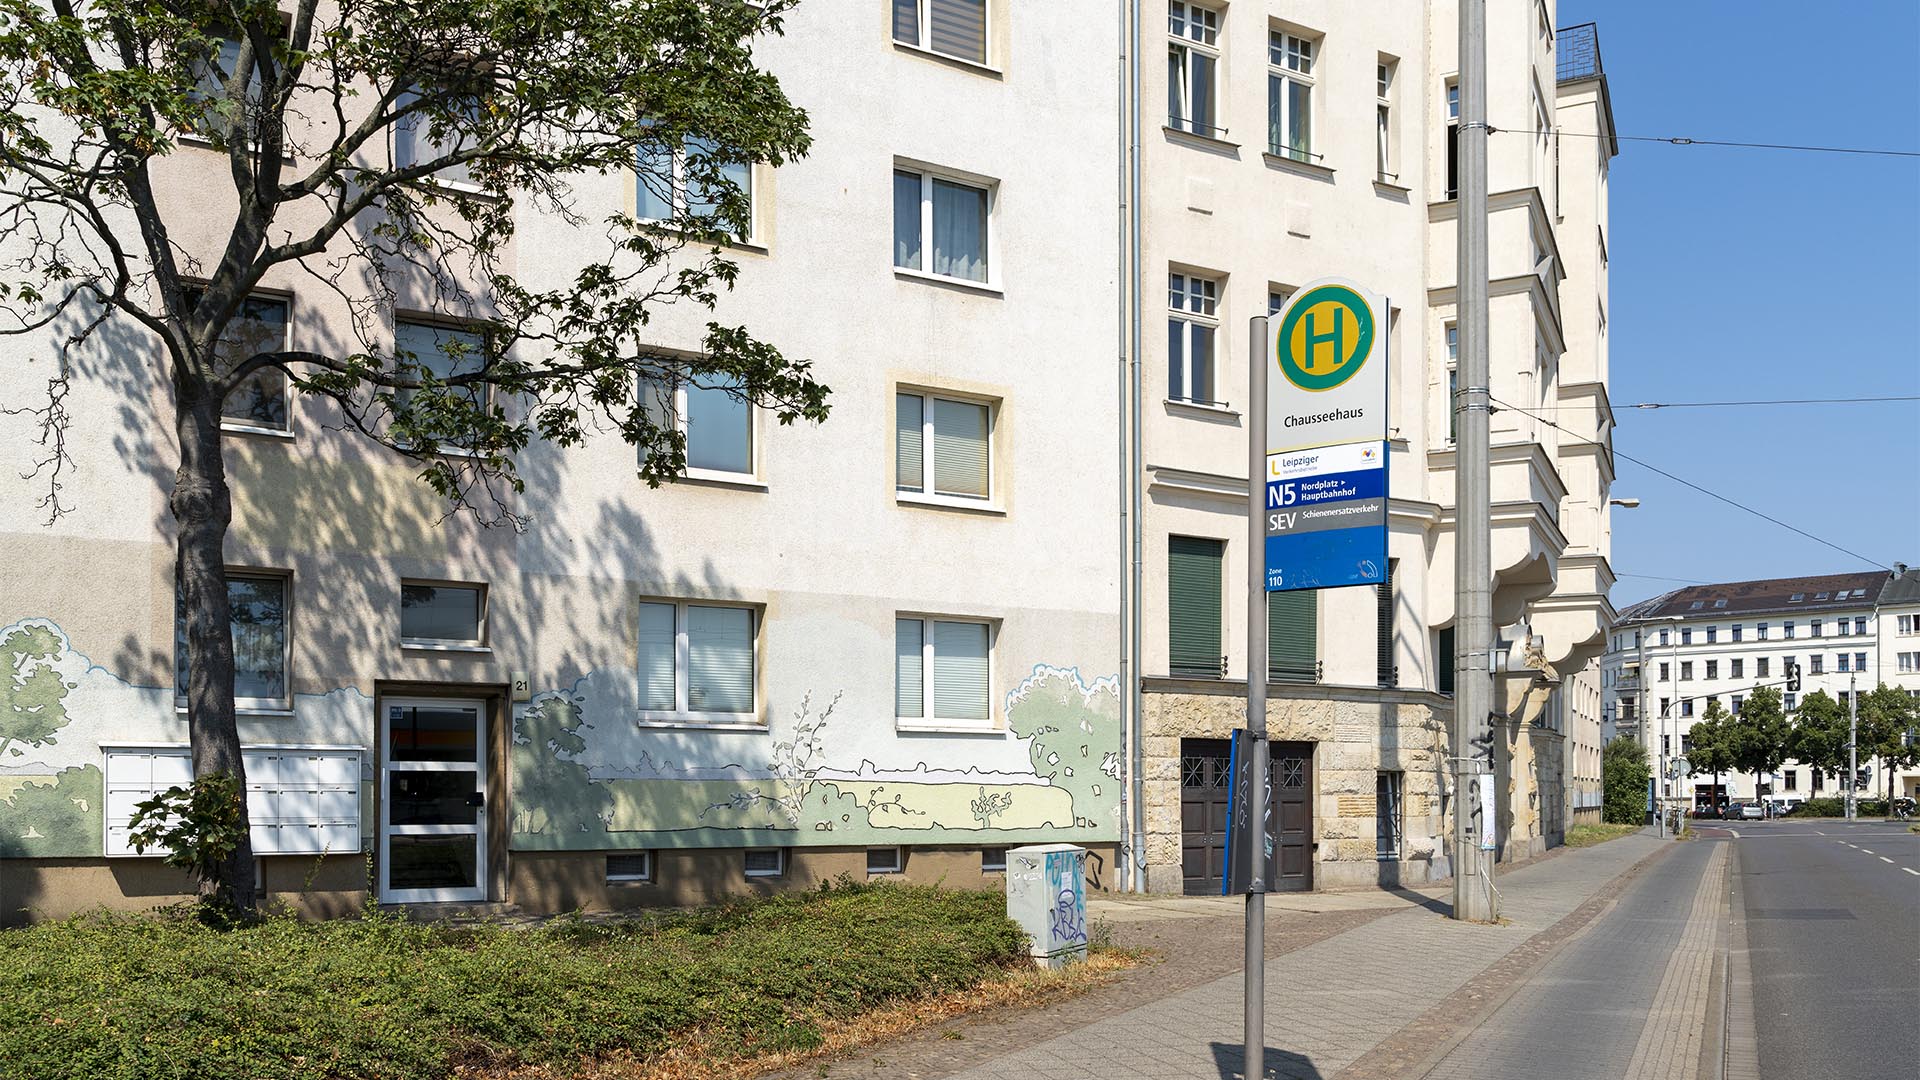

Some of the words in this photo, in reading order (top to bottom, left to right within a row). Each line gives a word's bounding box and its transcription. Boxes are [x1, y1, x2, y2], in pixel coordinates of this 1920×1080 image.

[1284, 408, 1364, 428] Chausseehaus
[1282, 455, 1319, 467] Leipziger
[1301, 480, 1339, 491] Nordplatz
[1269, 482, 1297, 507] N5
[1301, 487, 1357, 502] Hauptbahnhof
[1302, 503, 1379, 519] Schienenersatzverkehr
[1269, 512, 1297, 531] SEV
[1269, 576, 1283, 587] 110
[515, 681, 528, 691] 21
